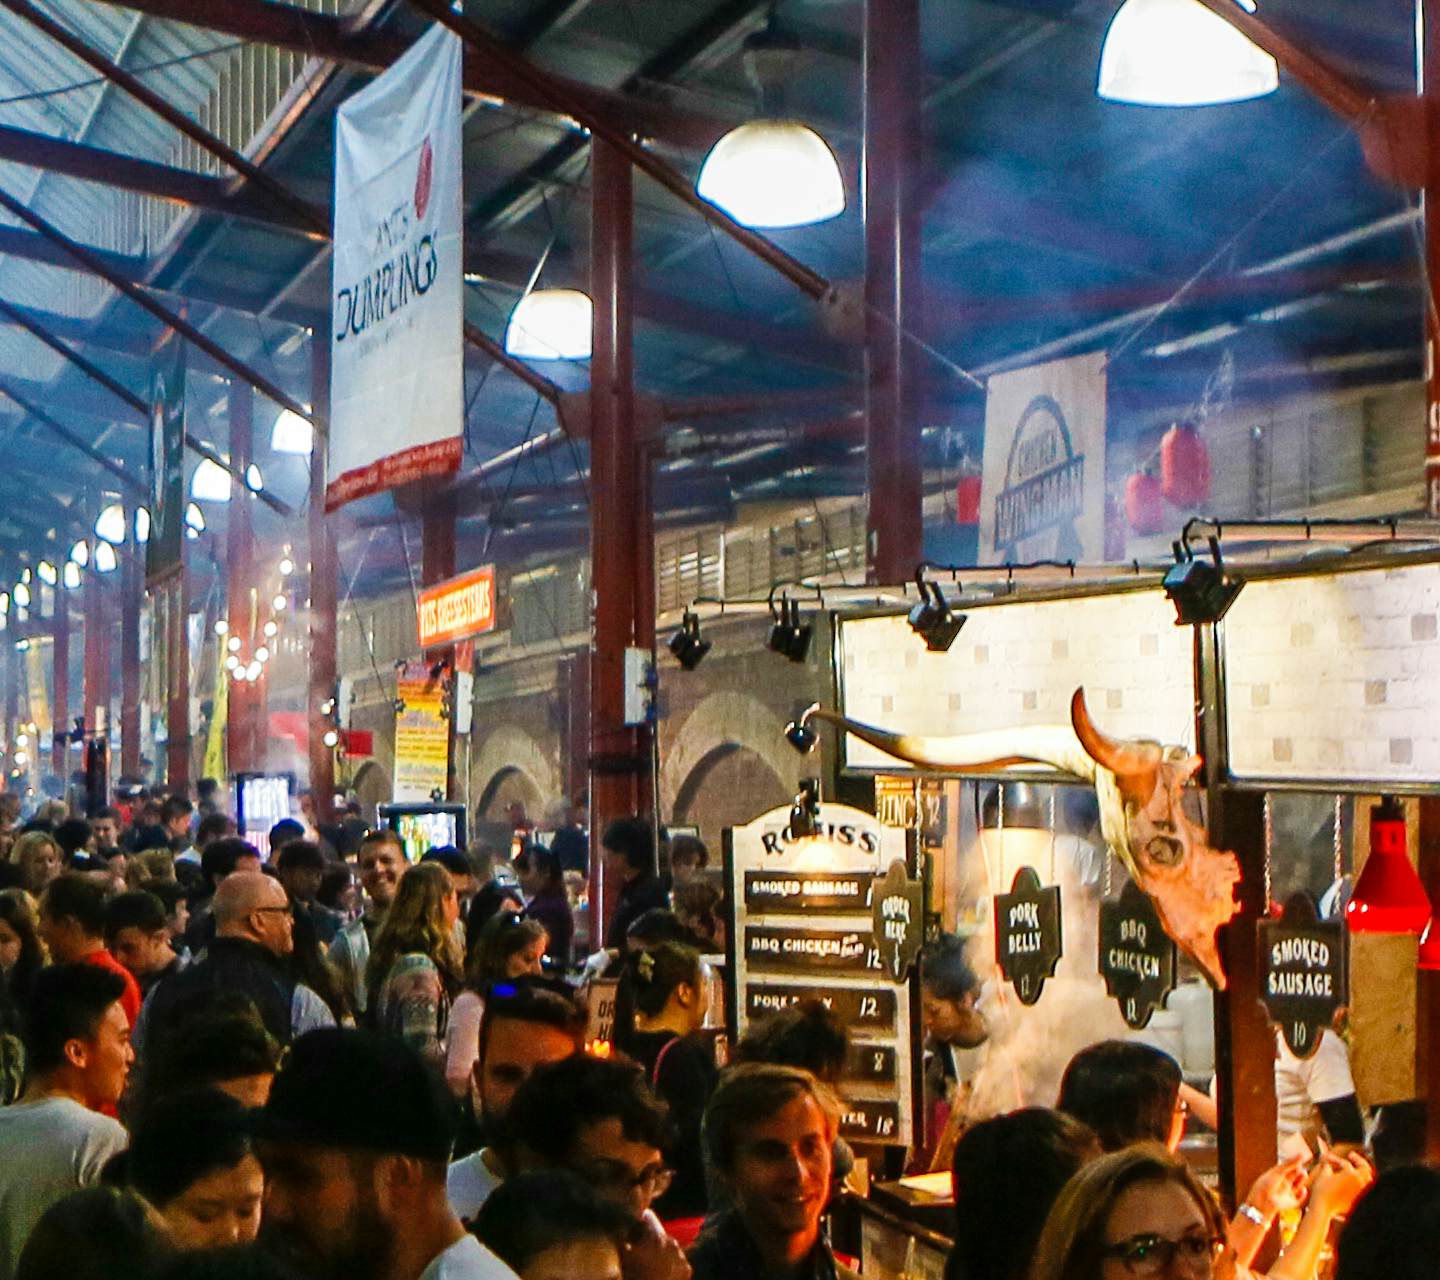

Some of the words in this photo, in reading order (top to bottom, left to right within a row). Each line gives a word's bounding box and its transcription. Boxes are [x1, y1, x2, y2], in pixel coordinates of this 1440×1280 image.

[762, 824, 879, 855] ROISS
[752, 880, 801, 897] SMOKED
[803, 880, 859, 896] SAUSAGE
[1009, 902, 1040, 928] PORK
[1008, 931, 1042, 954] BELLY
[1121, 919, 1147, 947] BBQ
[752, 937, 780, 953] BBQ
[783, 937, 840, 957] CHICKEN
[866, 948, 883, 970] 12
[1109, 947, 1160, 982] CHICKEN
[1271, 937, 1330, 967] SMOKED
[1268, 971, 1333, 997] SAUSAGE
[753, 994, 788, 1010] PORK
[859, 996, 878, 1017] 12
[1292, 1021, 1306, 1047] 10
[874, 1052, 884, 1072] 8
[876, 1115, 894, 1136] 18
